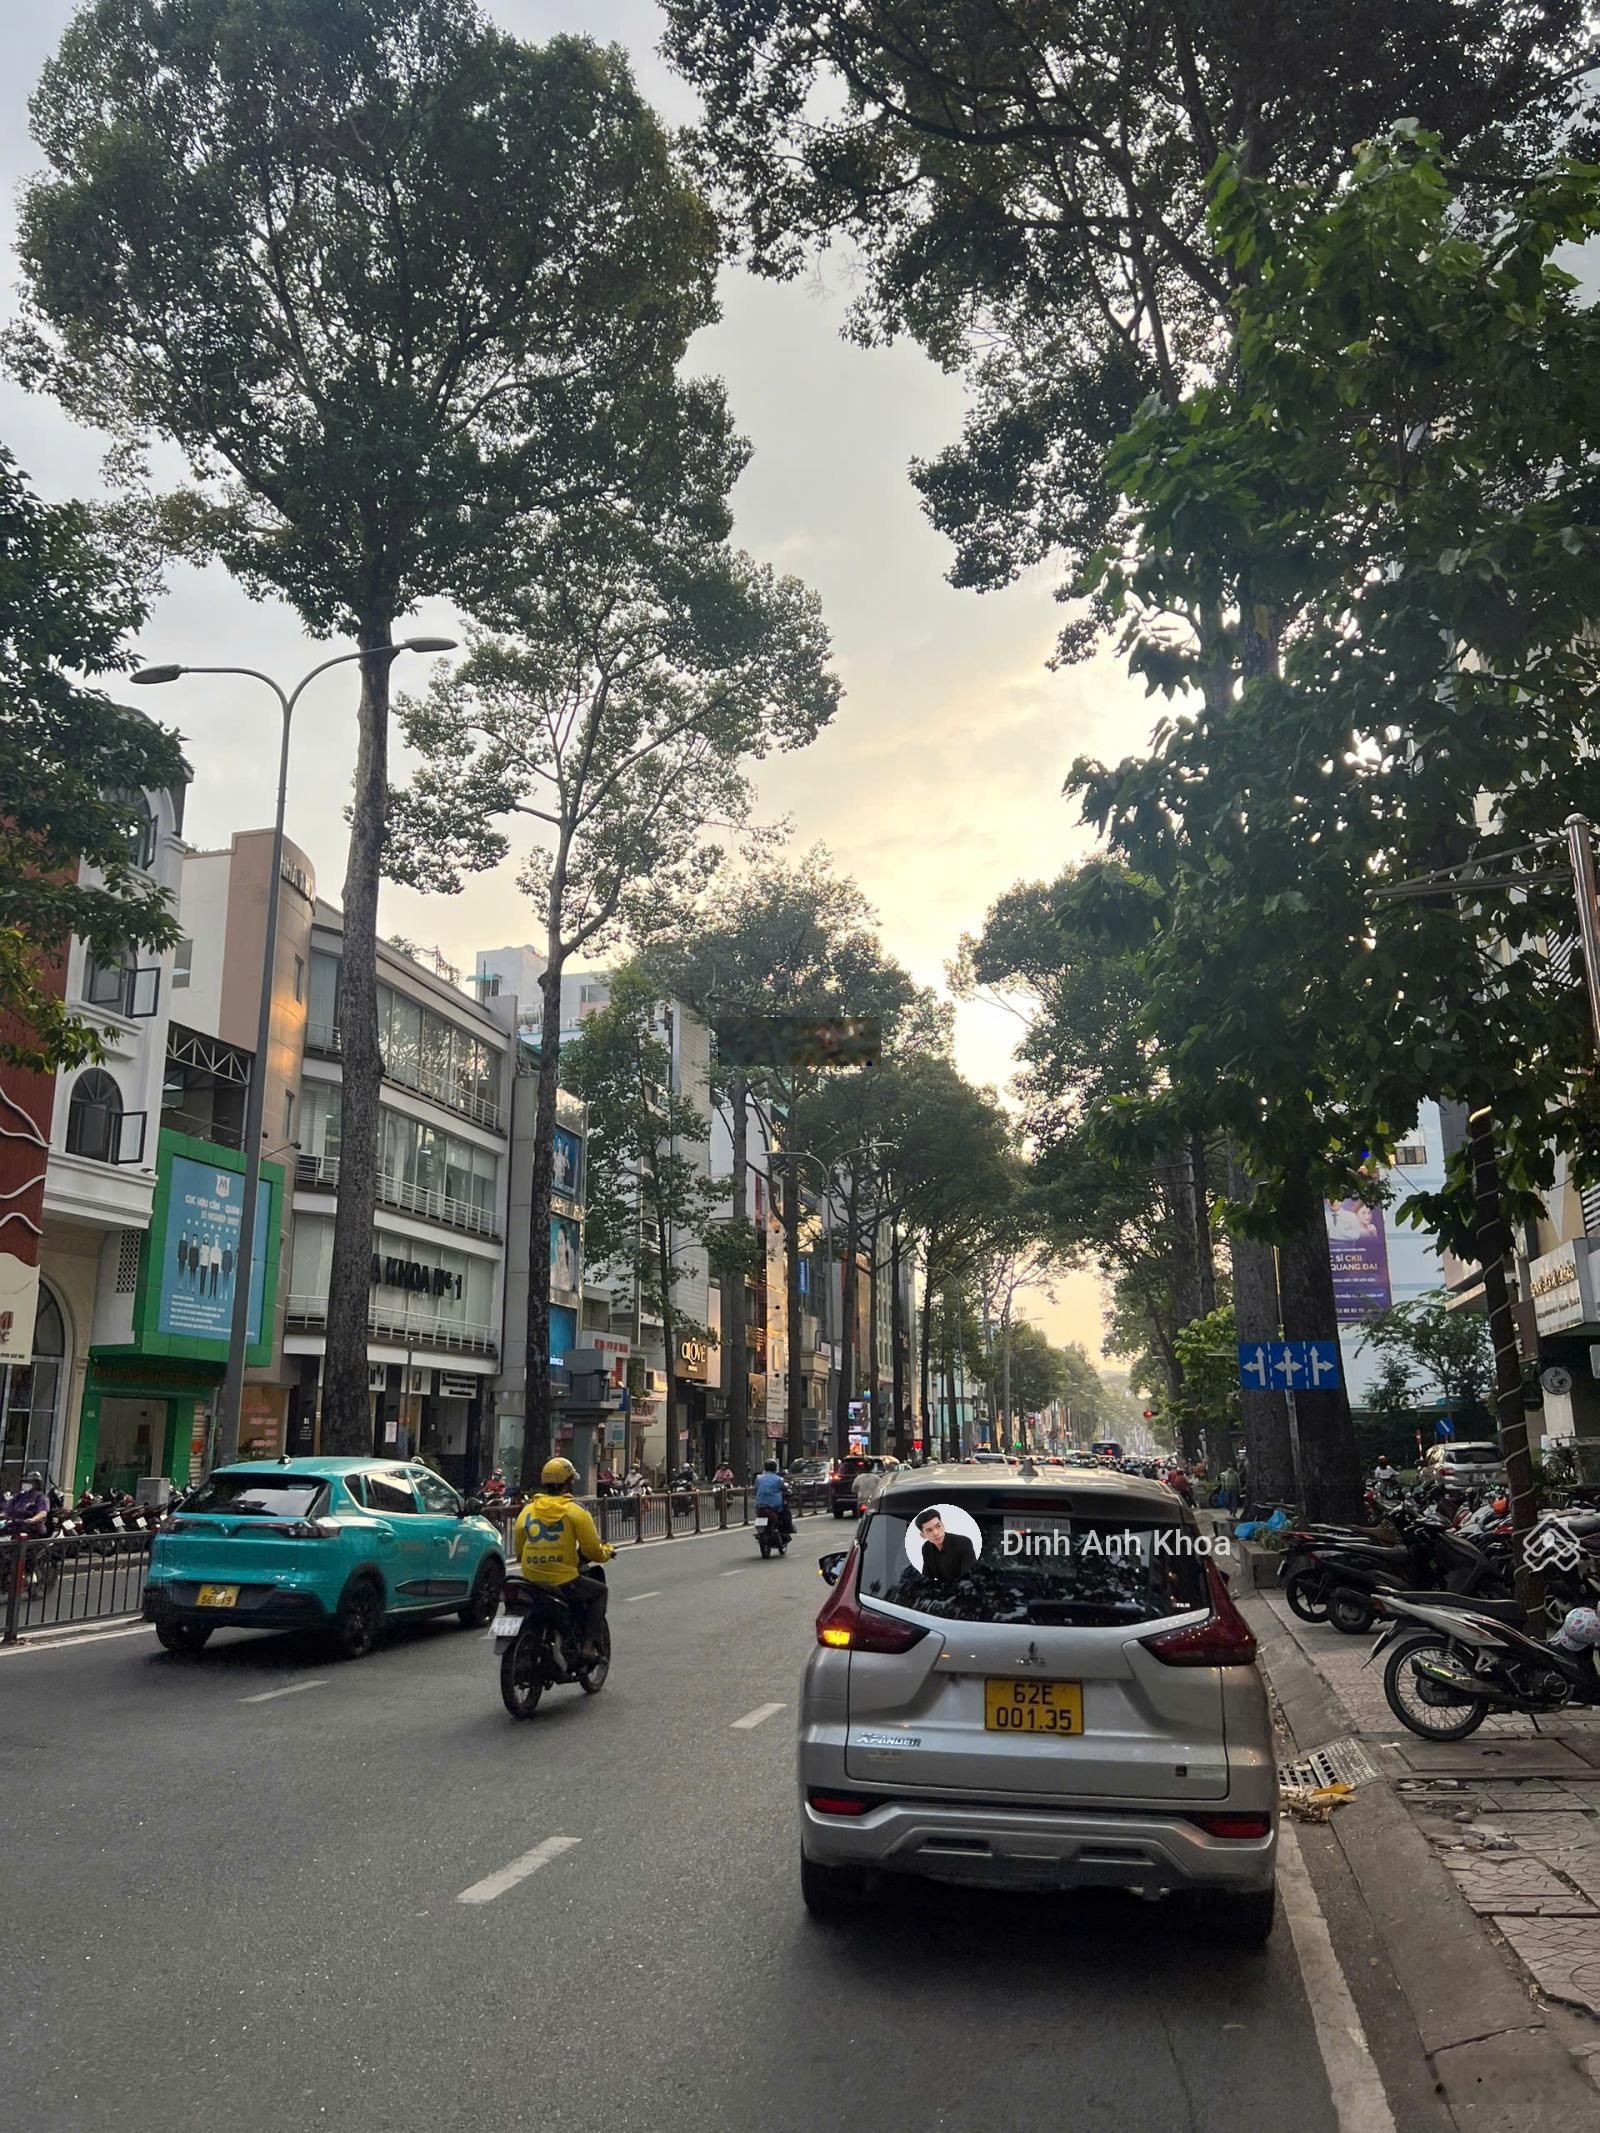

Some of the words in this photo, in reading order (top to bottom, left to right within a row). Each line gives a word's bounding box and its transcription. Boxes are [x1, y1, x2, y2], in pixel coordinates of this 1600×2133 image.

[1330, 1263, 1361, 1271] QUANG
[525, 1513, 564, 1542] be
[1014, 1684, 1053, 1705] 62E
[997, 1707, 1072, 1730] 001.35
